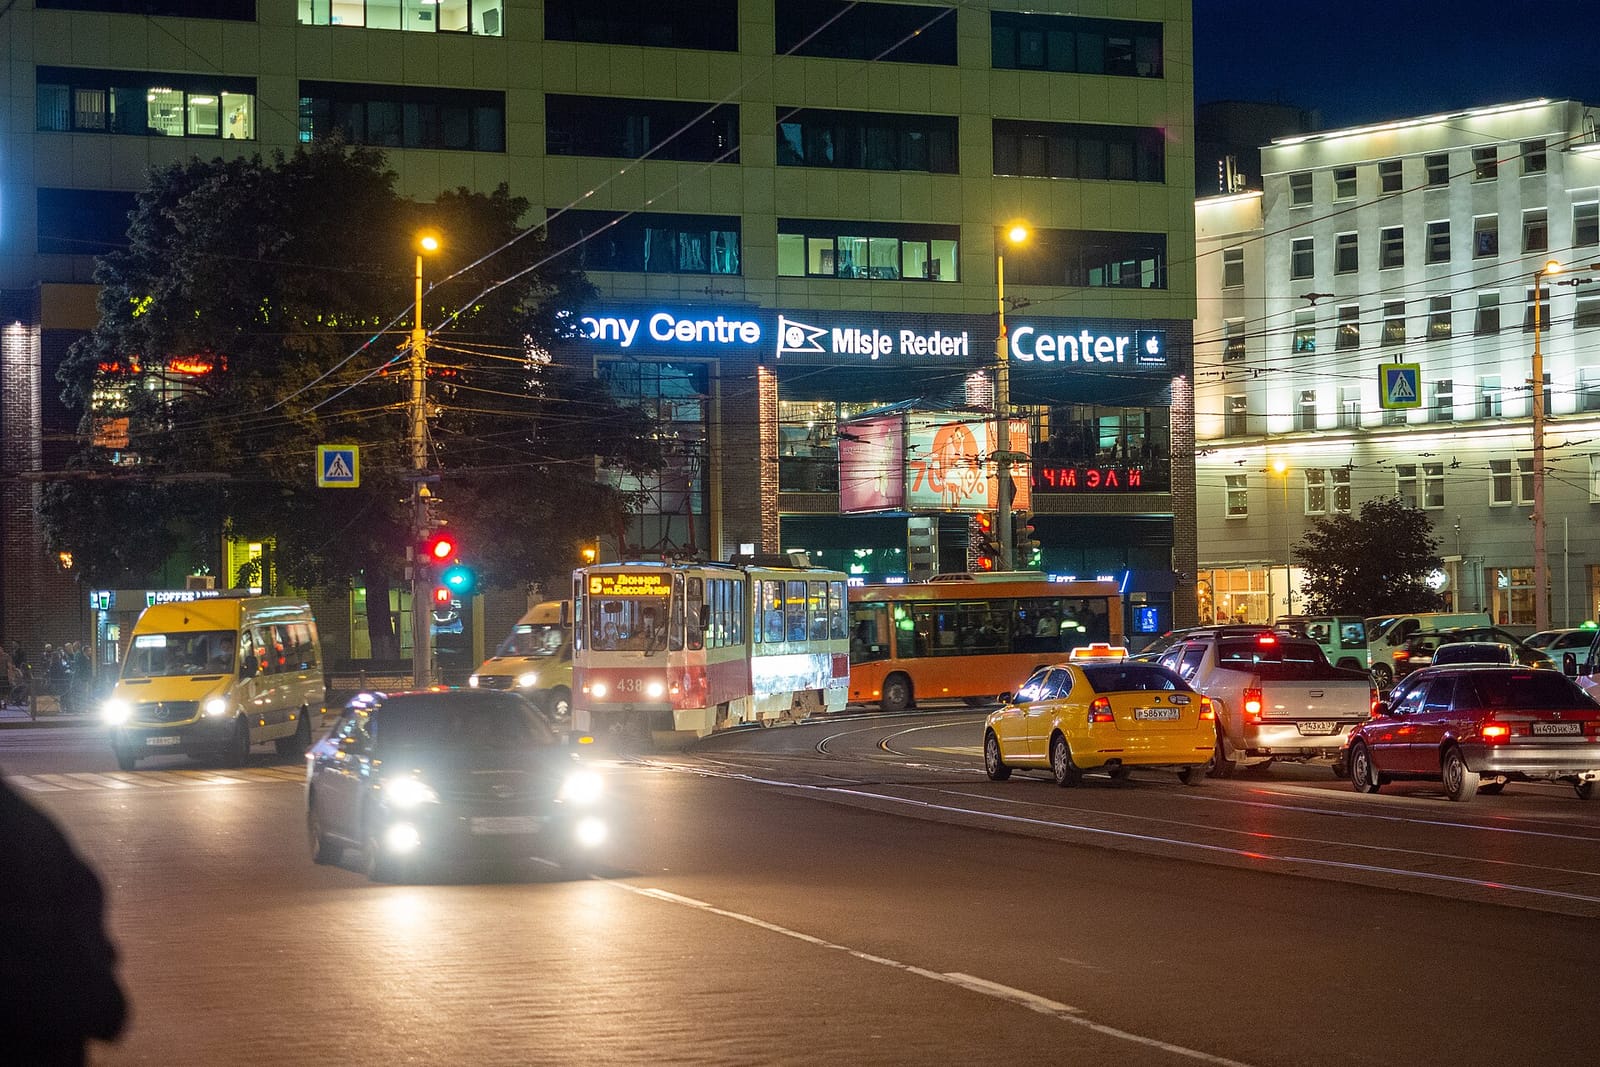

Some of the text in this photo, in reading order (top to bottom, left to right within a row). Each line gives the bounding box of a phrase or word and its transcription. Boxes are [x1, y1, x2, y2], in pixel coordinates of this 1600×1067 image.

[558, 312, 761, 347] ony Centre
[900, 329, 969, 356] Rederi
[1011, 326, 1129, 363] Center
[156, 591, 195, 602] COFFEE
[590, 577, 602, 594] 5
[616, 678, 643, 692] 438
